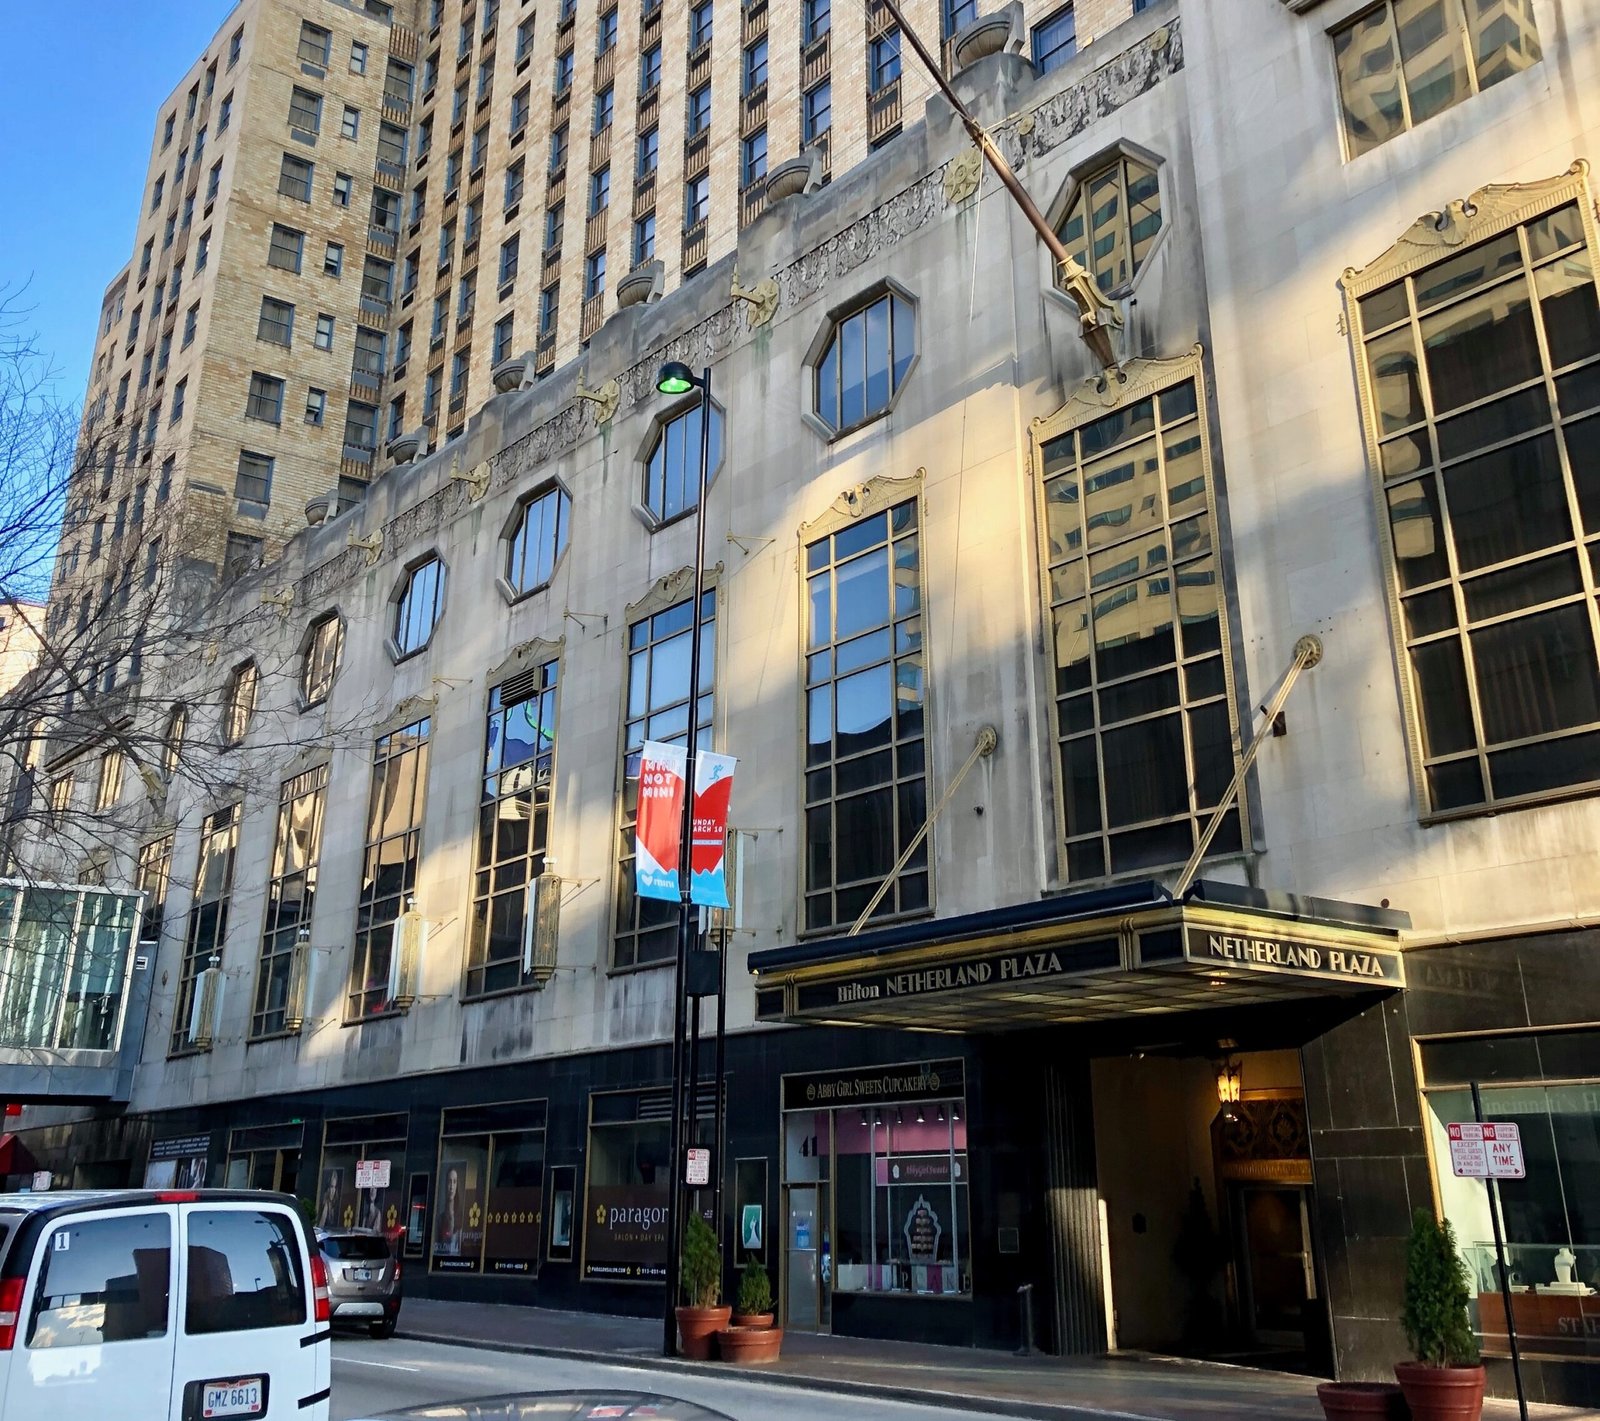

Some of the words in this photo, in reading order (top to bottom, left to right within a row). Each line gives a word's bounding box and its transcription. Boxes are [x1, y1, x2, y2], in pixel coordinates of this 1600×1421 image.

[644, 773, 672, 785] NOT
[643, 786, 674, 798] MINI
[693, 818, 716, 826] UNDAY
[1209, 934, 1322, 969] NETHERLAND
[1329, 950, 1384, 977] PLAZA
[838, 982, 880, 1002] Hilton
[886, 962, 992, 996] NETHERLAND
[1000, 952, 1062, 979] PLAZA
[1449, 1127, 1461, 1138] NO
[1483, 1127, 1495, 1138] NO
[798, 1136, 817, 1157] 41
[1493, 1144, 1511, 1153] ANY
[1493, 1156, 1515, 1166] TIME
[59, 1233, 66, 1249] 1
[614, 1233, 633, 1241] SALON
[208, 1391, 228, 1408] GMZ
[231, 1388, 257, 1406] 6613
